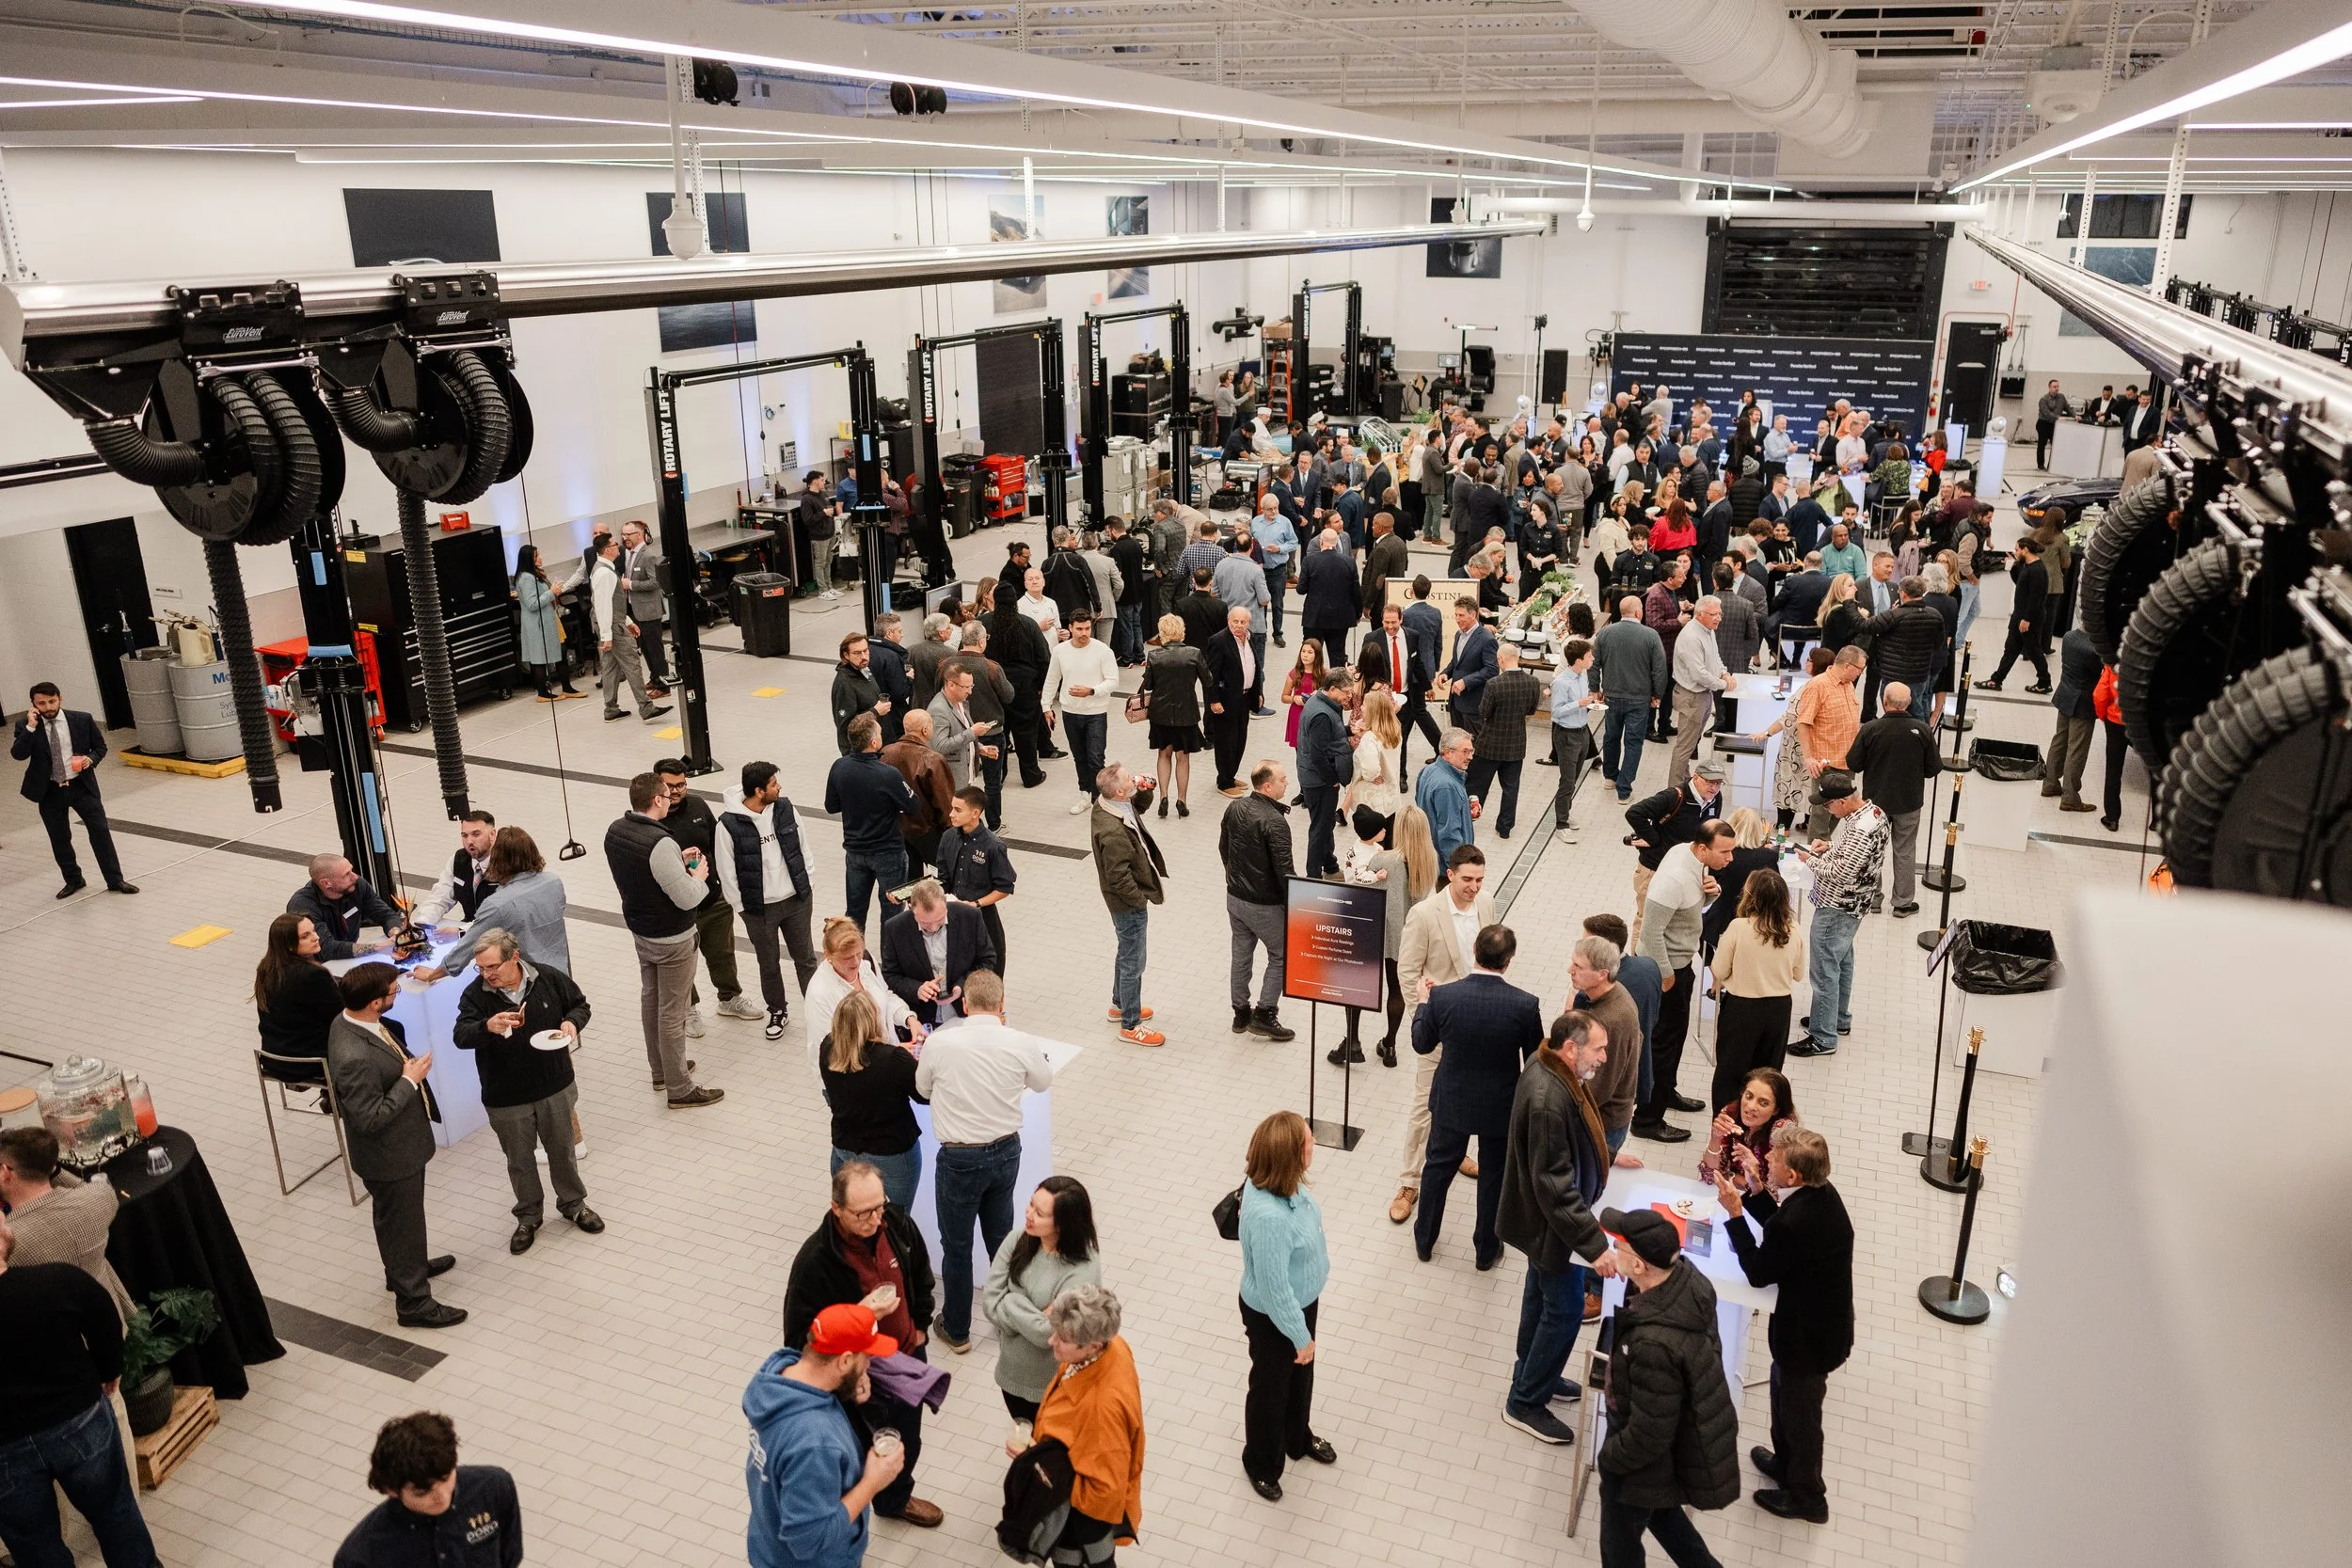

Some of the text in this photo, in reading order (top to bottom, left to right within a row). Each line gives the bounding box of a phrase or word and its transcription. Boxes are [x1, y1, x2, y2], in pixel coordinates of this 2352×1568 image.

[2340, 342, 2350, 363] LIFT
[922, 352, 933, 417] ROTARY LIFT
[659, 390, 671, 418] LIFT
[661, 421, 676, 472] ROTARY
[1317, 896, 1352, 905] PORSCHE
[1316, 924, 1352, 936] UPSTAIRS
